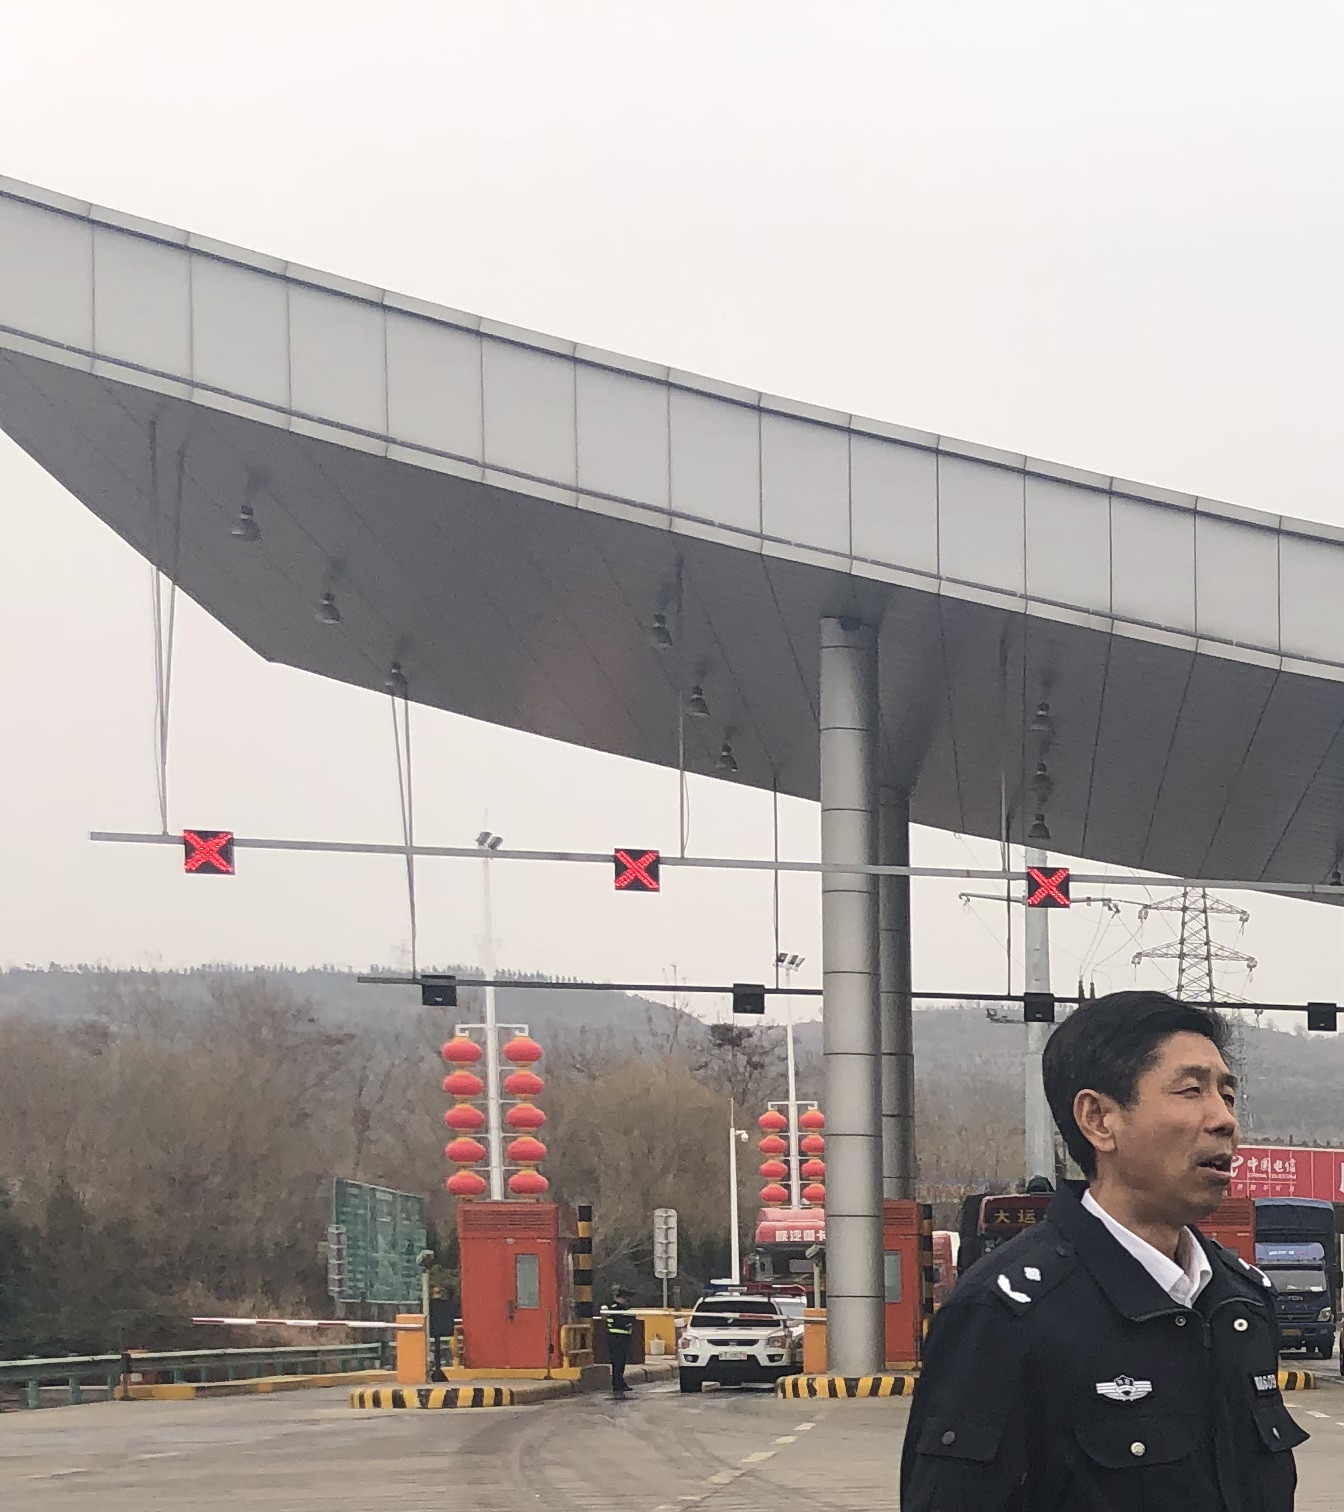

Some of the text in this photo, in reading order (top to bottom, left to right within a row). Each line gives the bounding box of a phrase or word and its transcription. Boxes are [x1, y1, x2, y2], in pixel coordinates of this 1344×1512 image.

[1246, 1156, 1297, 1173] 中国电信
[993, 1209, 1038, 1225] 大运
